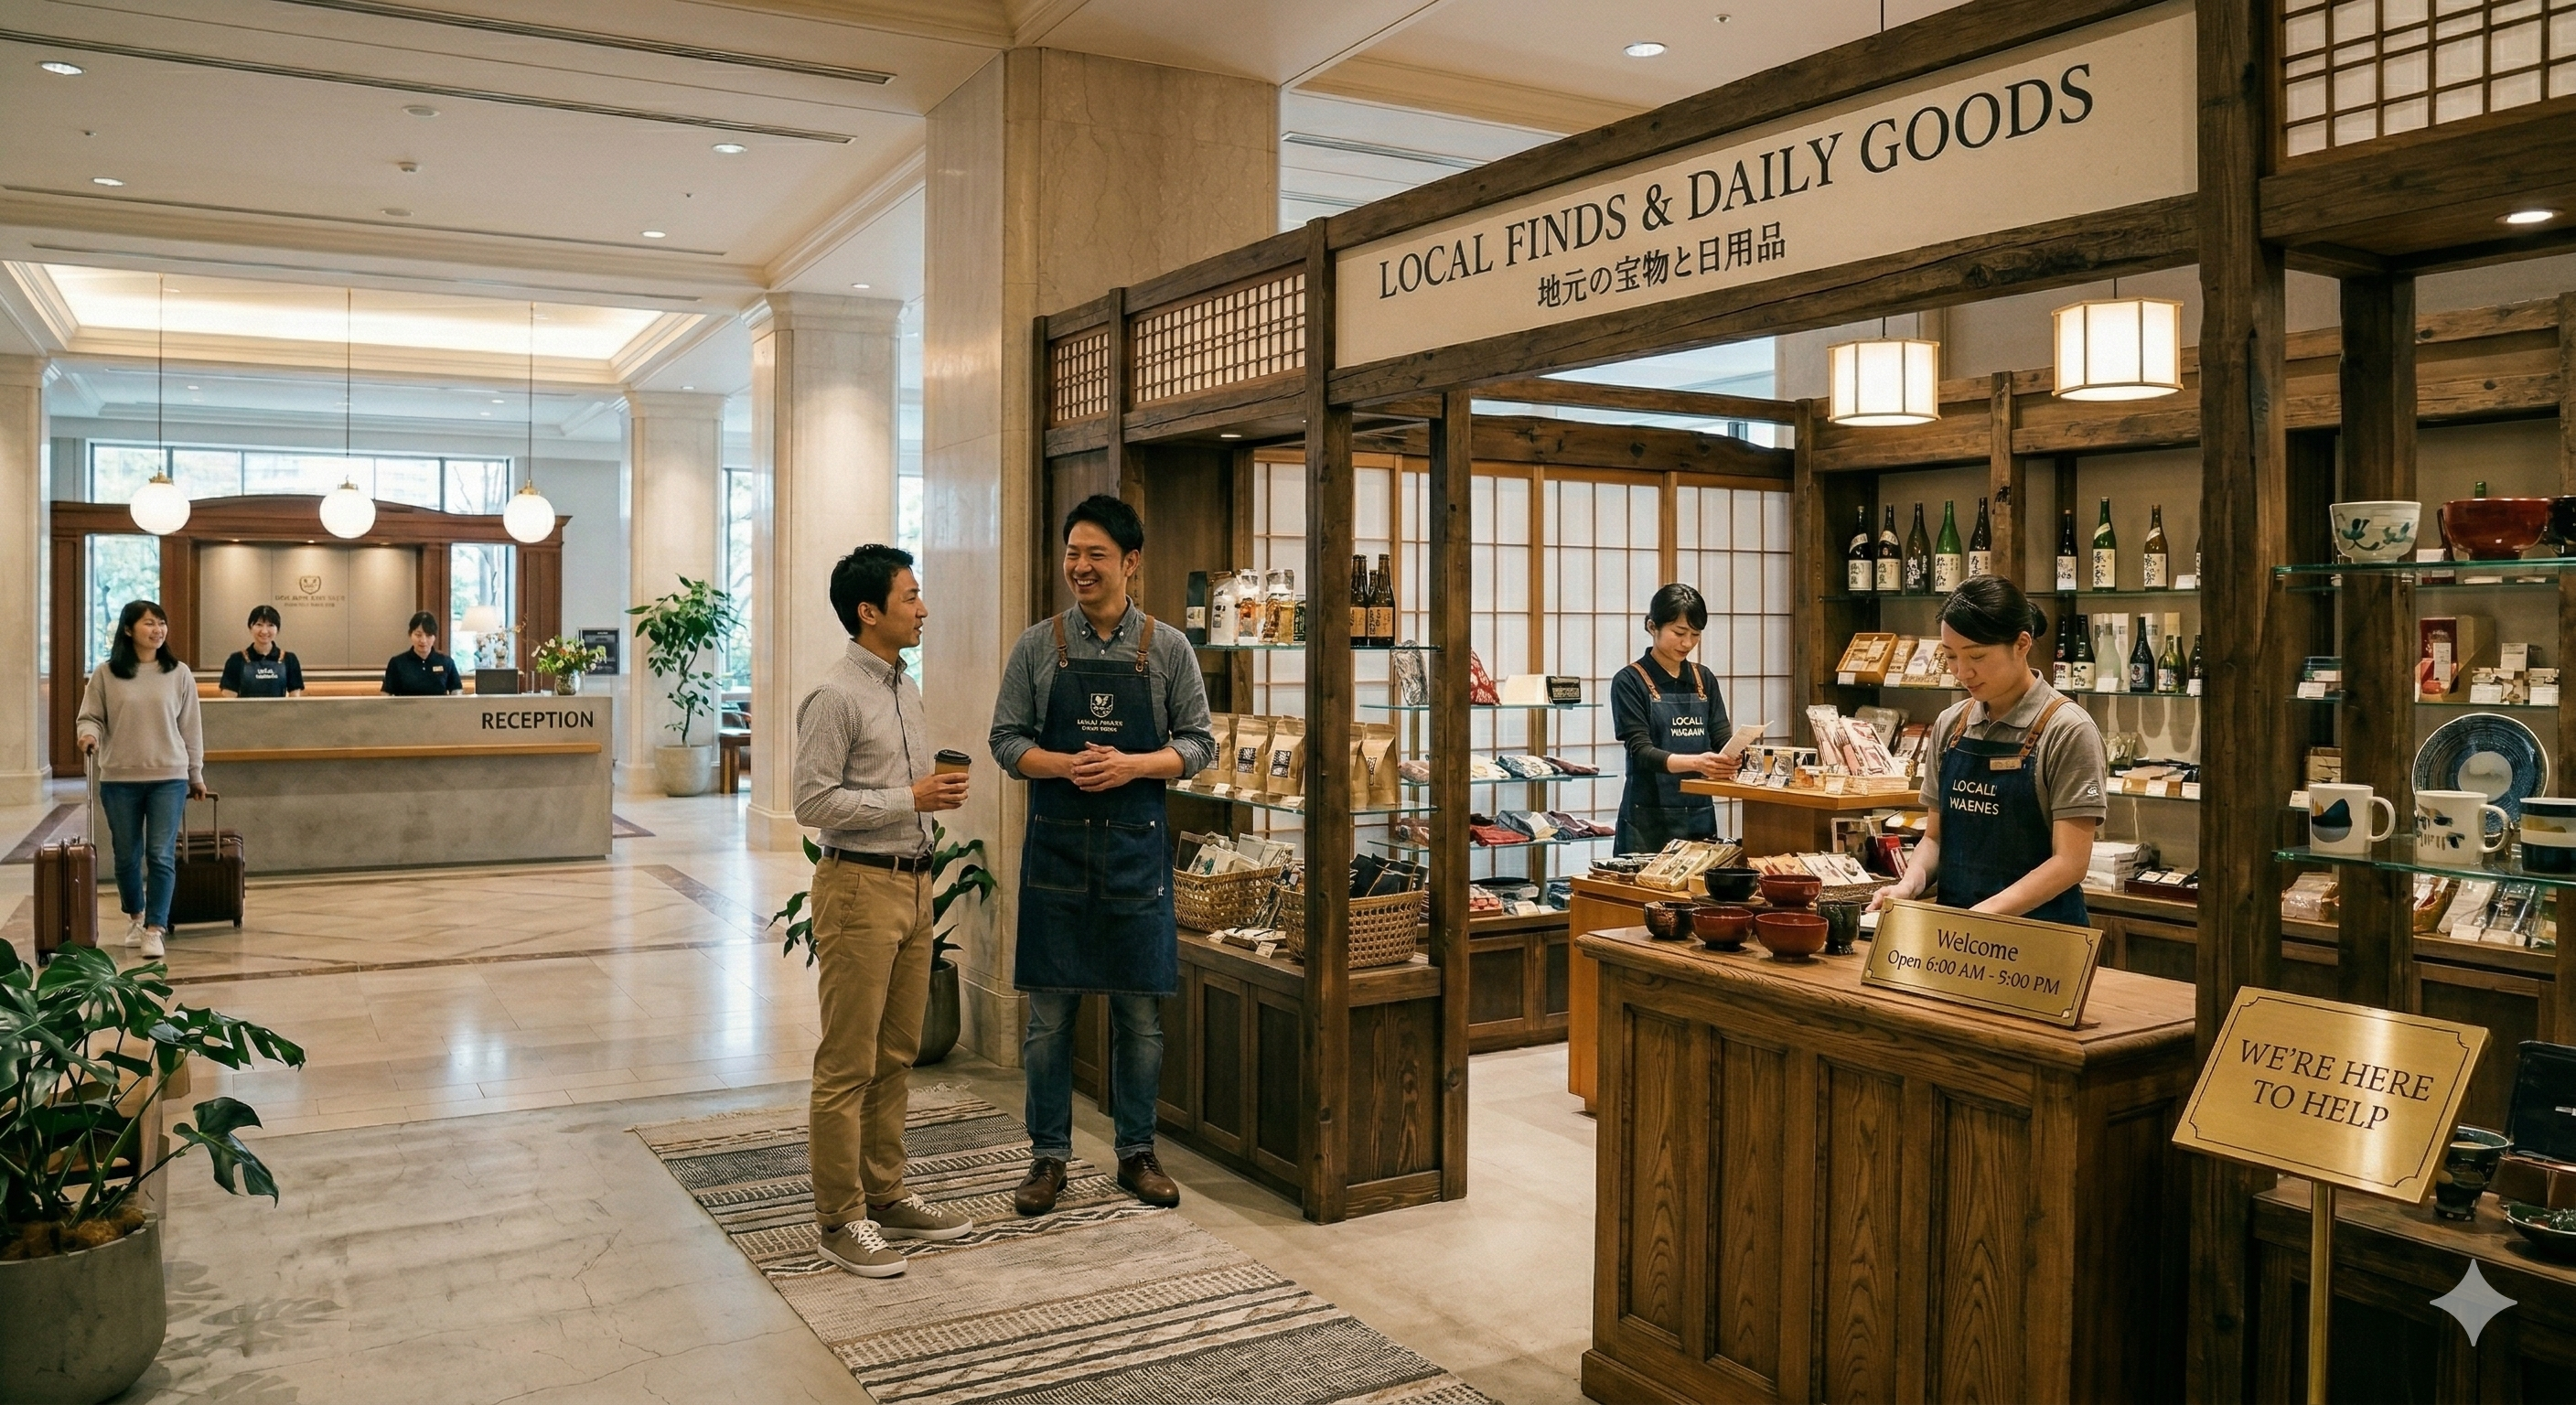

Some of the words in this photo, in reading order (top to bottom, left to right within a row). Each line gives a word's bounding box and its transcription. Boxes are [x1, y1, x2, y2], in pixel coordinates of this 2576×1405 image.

[1379, 232, 1494, 299] LOCAL
[1505, 193, 1627, 266] FINDS
[1641, 183, 1674, 231] &
[1687, 132, 1843, 220] DAILY
[1860, 63, 2094, 174] GOODS
[1537, 221, 1786, 308] 地元の宝物と日用品
[481, 710, 594, 730] RECEPTION
[1937, 928, 2019, 961] Welcome
[1888, 949, 1921, 970] Open
[1926, 956, 1957, 975] 6:00
[1958, 962, 1986, 981] AM
[1997, 970, 2030, 989] 5:00
[2033, 975, 2061, 995] PM
[2241, 1039, 2335, 1081] WE’RE
[2339, 1060, 2434, 1101] HERE
[2253, 1079, 2295, 1110] TO
[2300, 1090, 2389, 1130] HELP
